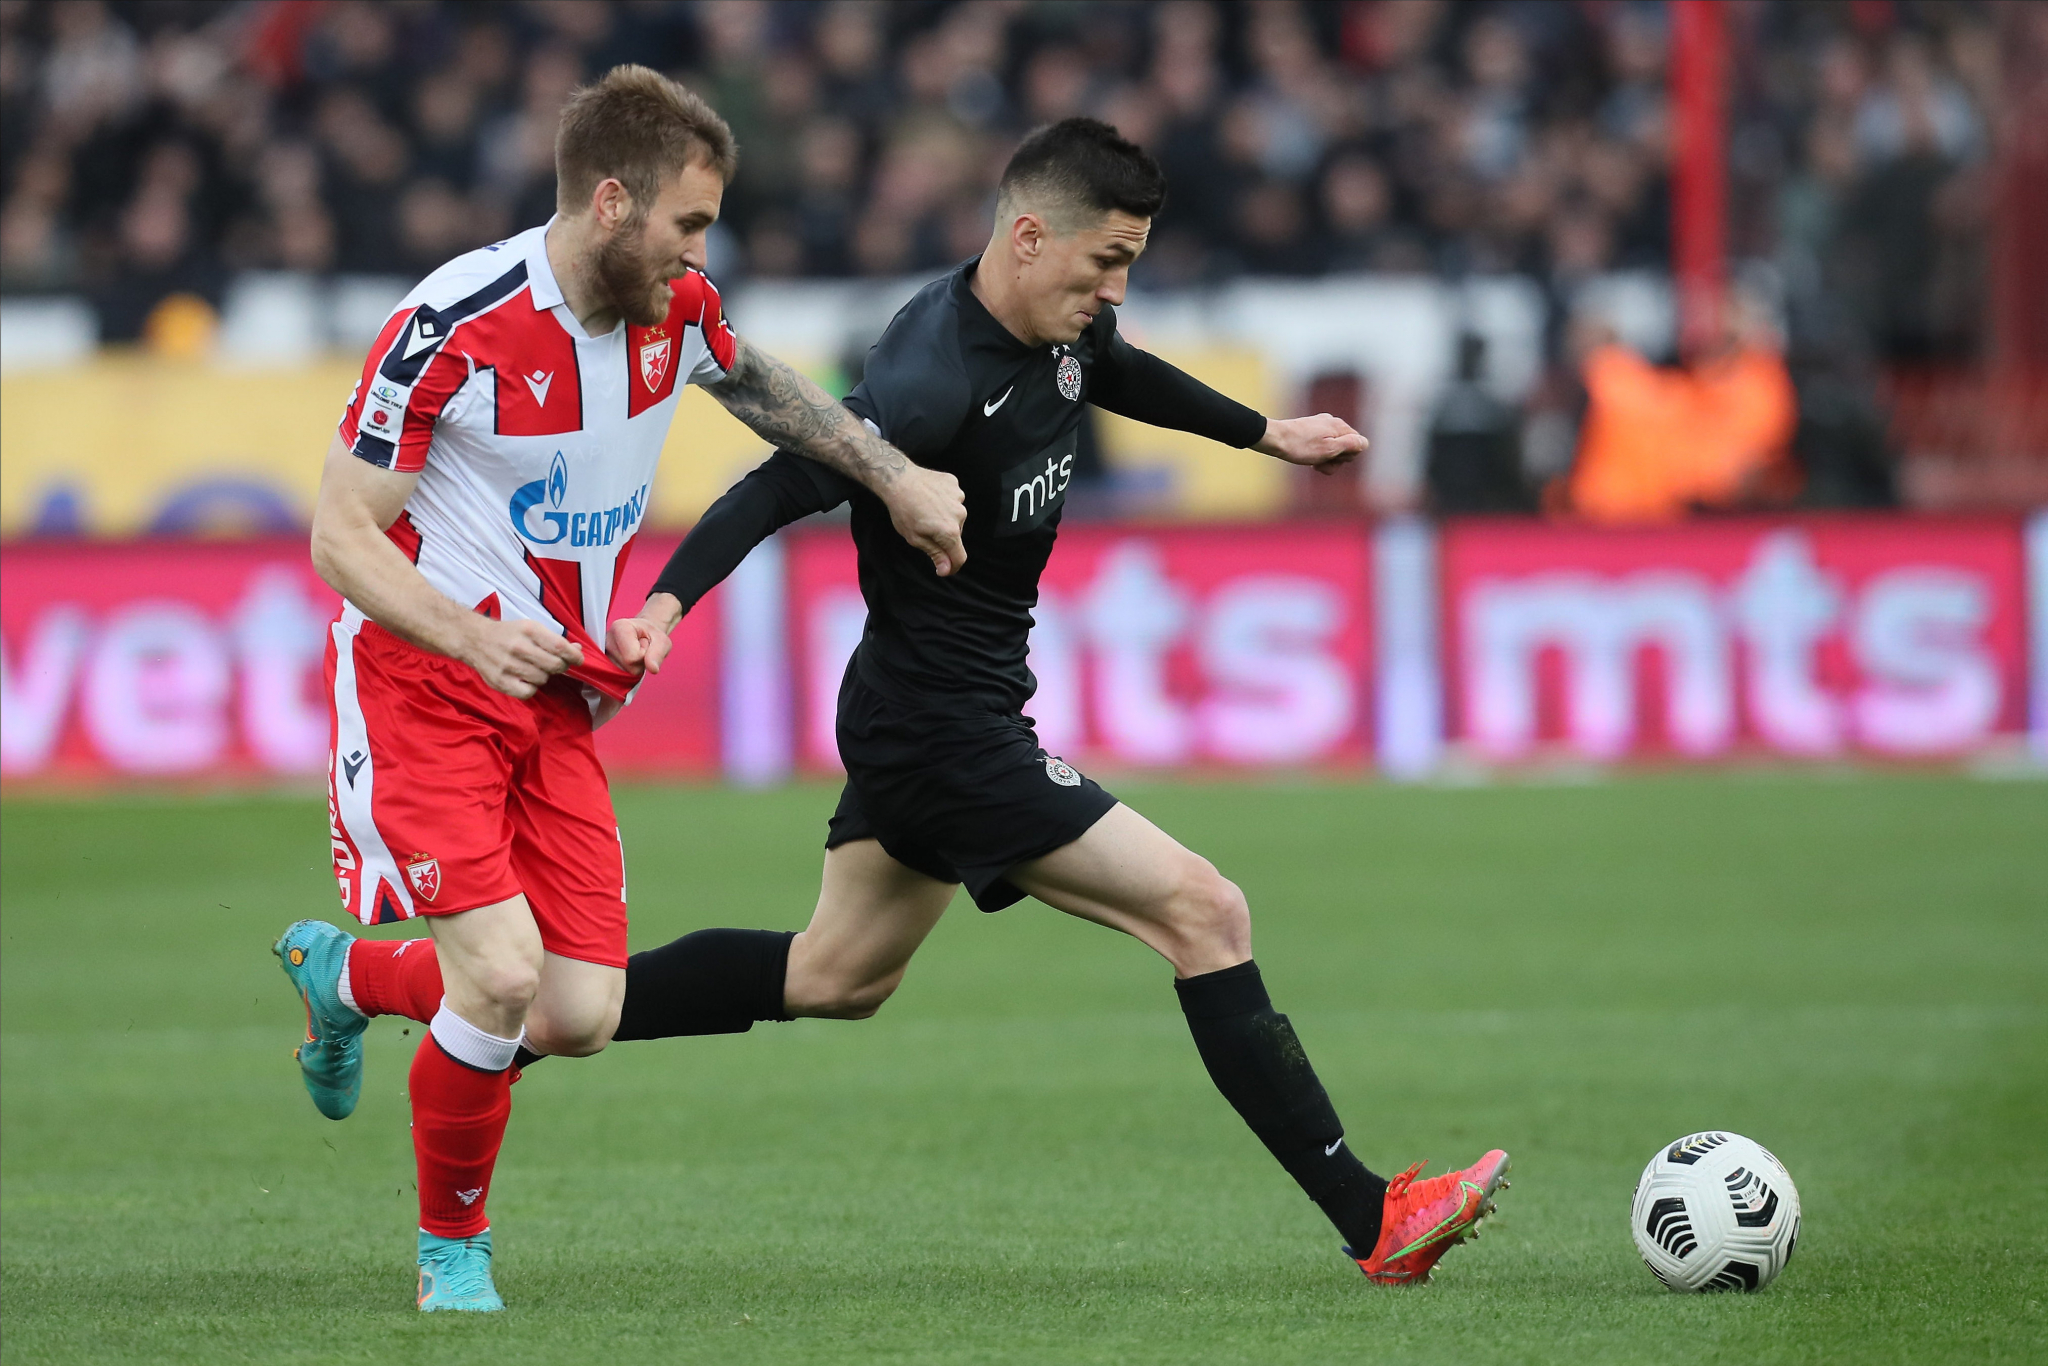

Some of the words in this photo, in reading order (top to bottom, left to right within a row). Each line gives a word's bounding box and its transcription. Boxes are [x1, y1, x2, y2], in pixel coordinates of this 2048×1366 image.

[571, 483, 646, 547] GAZPM
[1011, 454, 1072, 522] mts
[1468, 532, 1998, 760] mts
